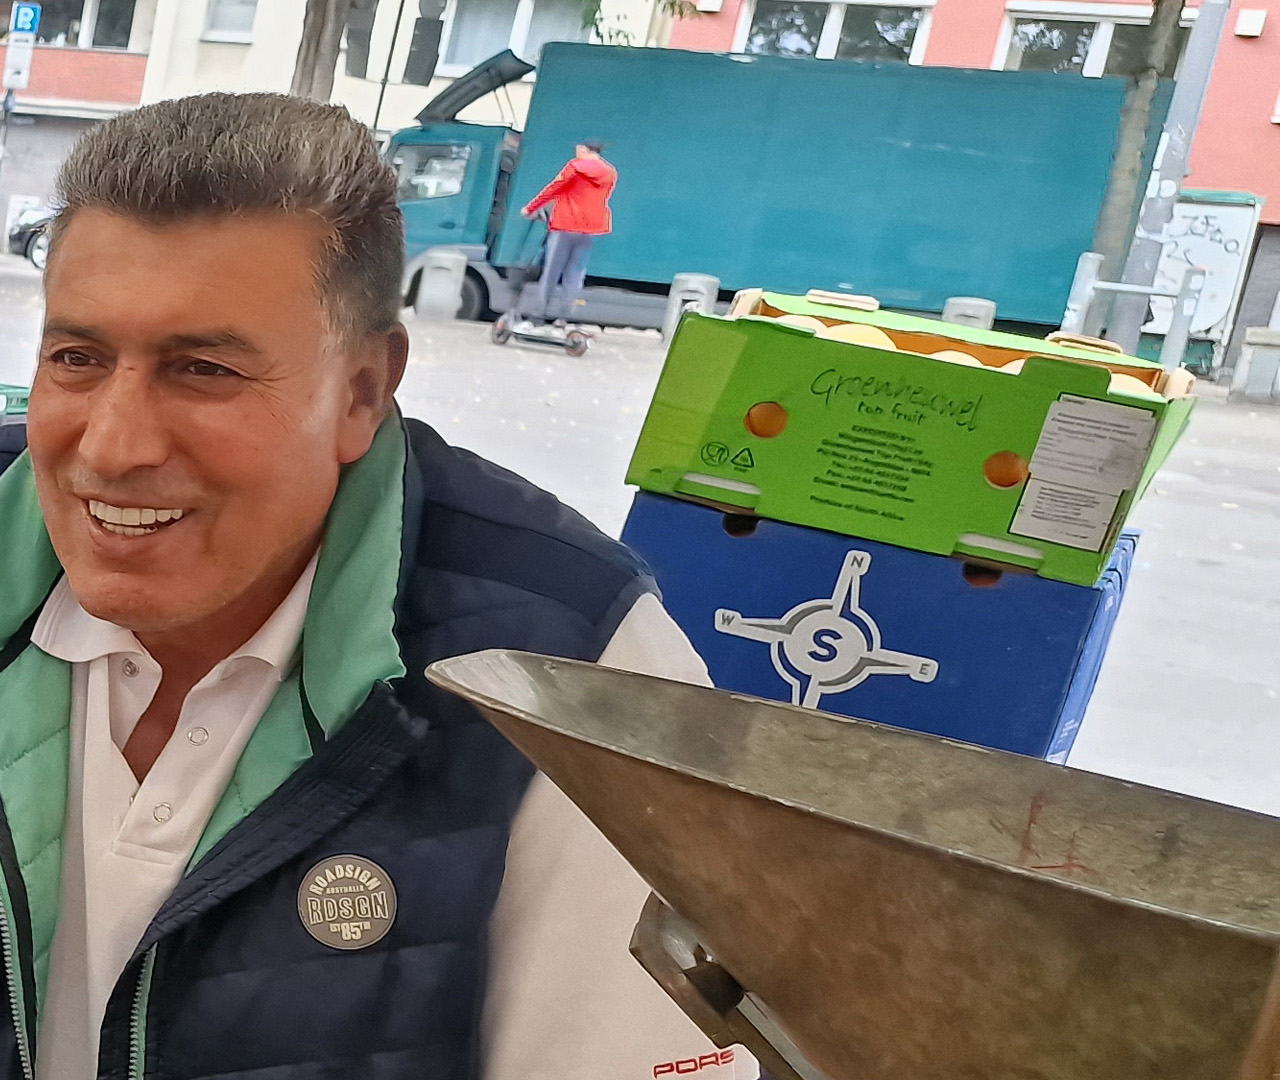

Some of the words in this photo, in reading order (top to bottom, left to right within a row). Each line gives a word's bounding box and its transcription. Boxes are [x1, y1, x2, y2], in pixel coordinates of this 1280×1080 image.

[850, 556, 864, 569] N
[721, 614, 735, 626] W
[807, 628, 843, 663] S
[918, 663, 930, 675] E
[309, 864, 381, 896] ROADSIGN
[307, 891, 389, 925] RDSGN
[341, 922, 362, 941] 85
[653, 1050, 735, 1079] PORS
